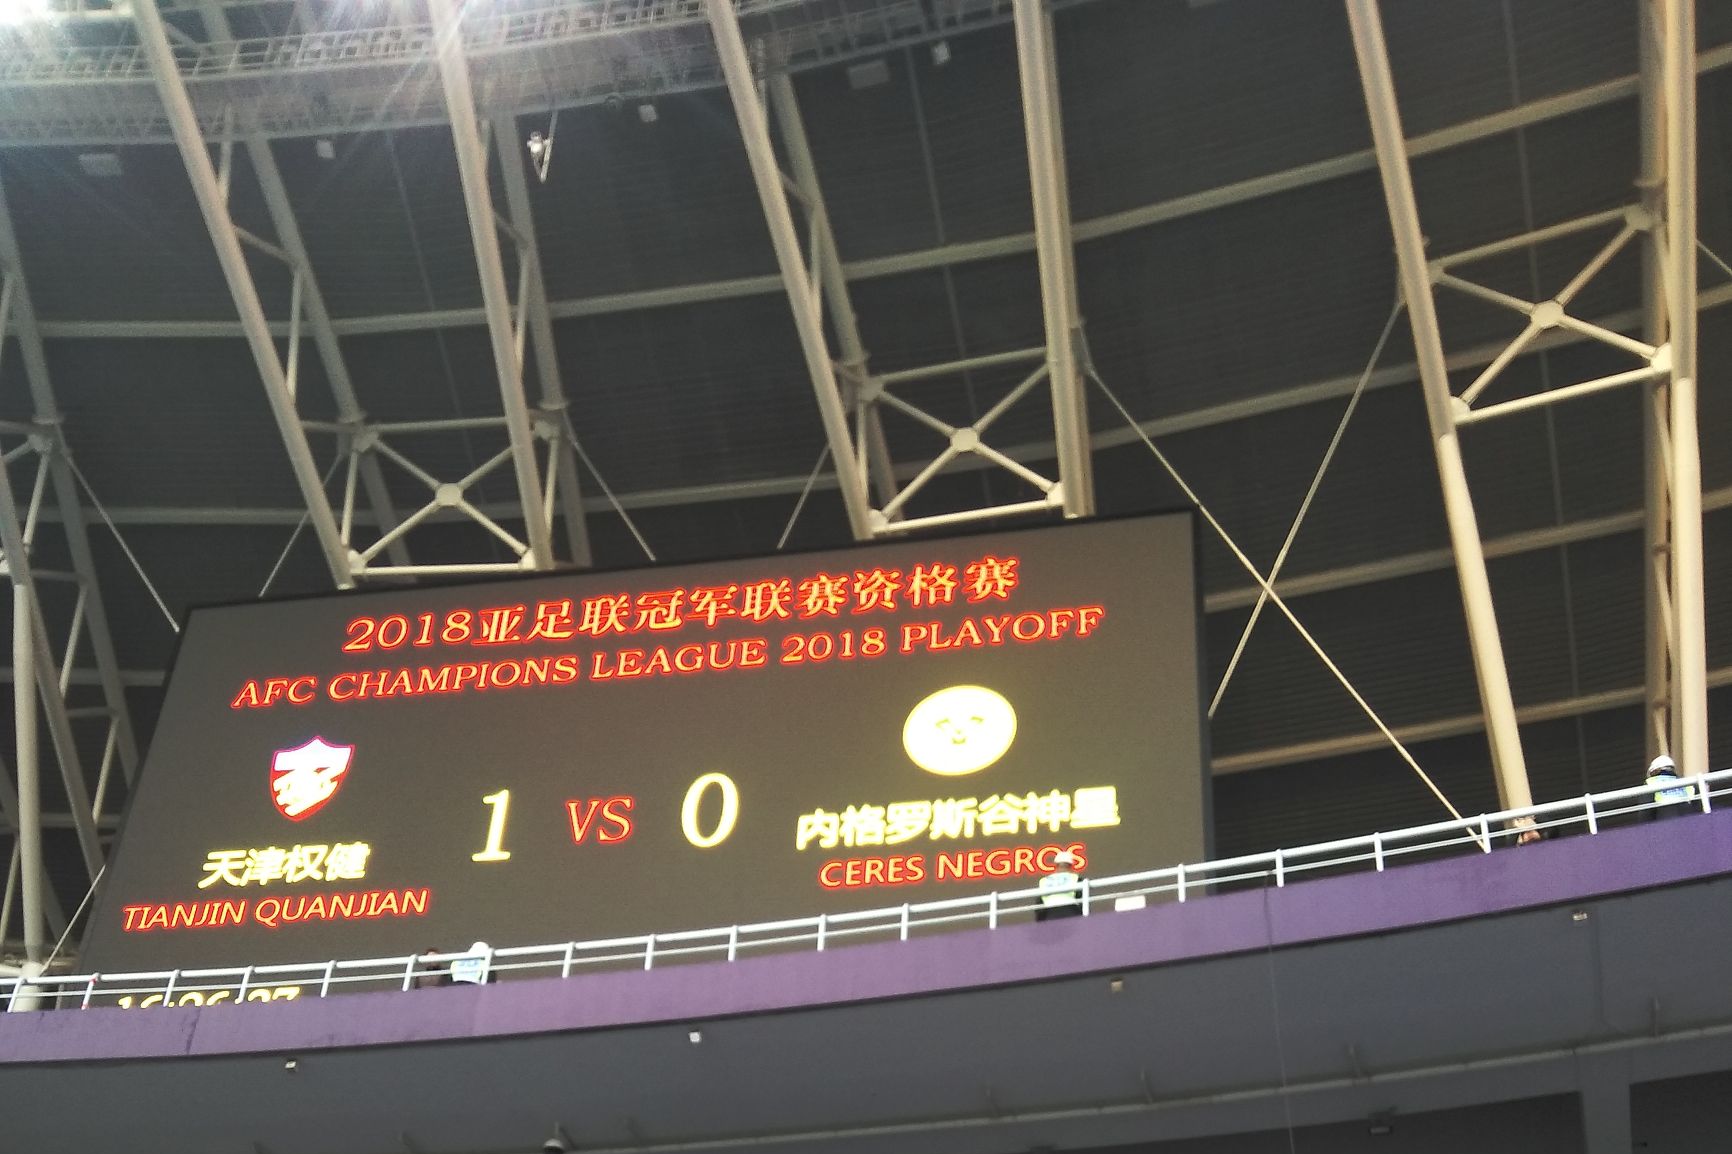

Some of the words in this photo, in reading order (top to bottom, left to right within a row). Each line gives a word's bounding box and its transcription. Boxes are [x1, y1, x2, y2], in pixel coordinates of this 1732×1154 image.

[342, 556, 1018, 654] 2018亚足联冠军联赛资格赛
[231, 677, 316, 708] AFC
[328, 654, 578, 701] CHAMPIONS
[591, 639, 767, 681] LEAGUE
[780, 628, 887, 665] 2018
[900, 606, 1105, 653] PLAYOFF
[472, 789, 511, 861] 1
[566, 797, 634, 844] VS
[681, 772, 739, 847] 0
[795, 786, 1121, 851] 内格罗斯谷神星
[197, 841, 371, 890] 天津权健
[818, 854, 925, 890] CERES
[936, 843, 1088, 882] NEGROS
[122, 899, 248, 931] TIANJIN
[254, 888, 430, 928] QUANJIAN
